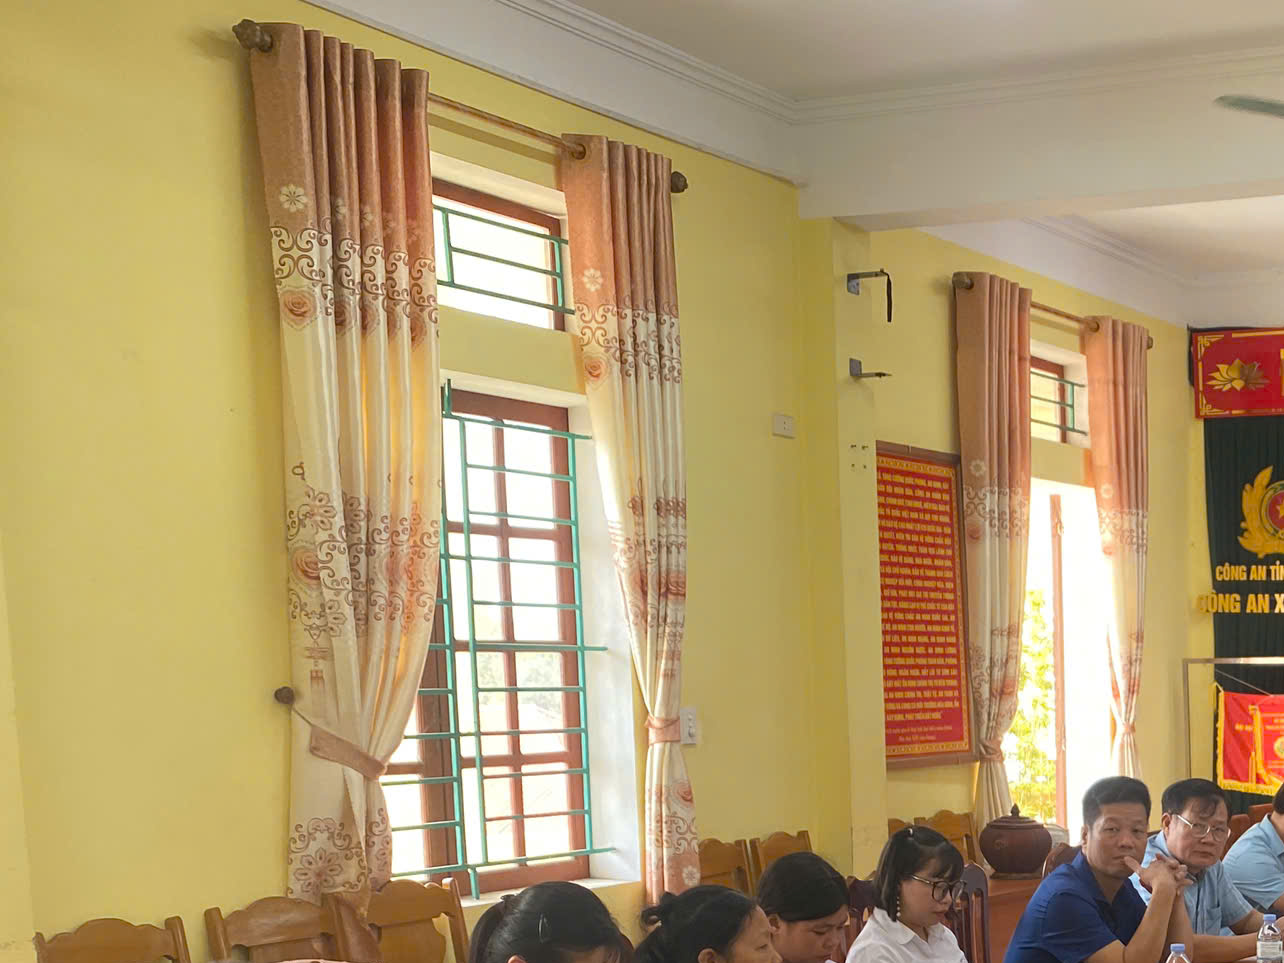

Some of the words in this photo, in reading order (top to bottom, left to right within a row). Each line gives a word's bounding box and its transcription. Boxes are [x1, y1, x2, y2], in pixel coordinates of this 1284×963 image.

[1215, 562, 1247, 581] CÔNG
[1250, 564, 1267, 581] AN
[1246, 594, 1269, 614] AN
